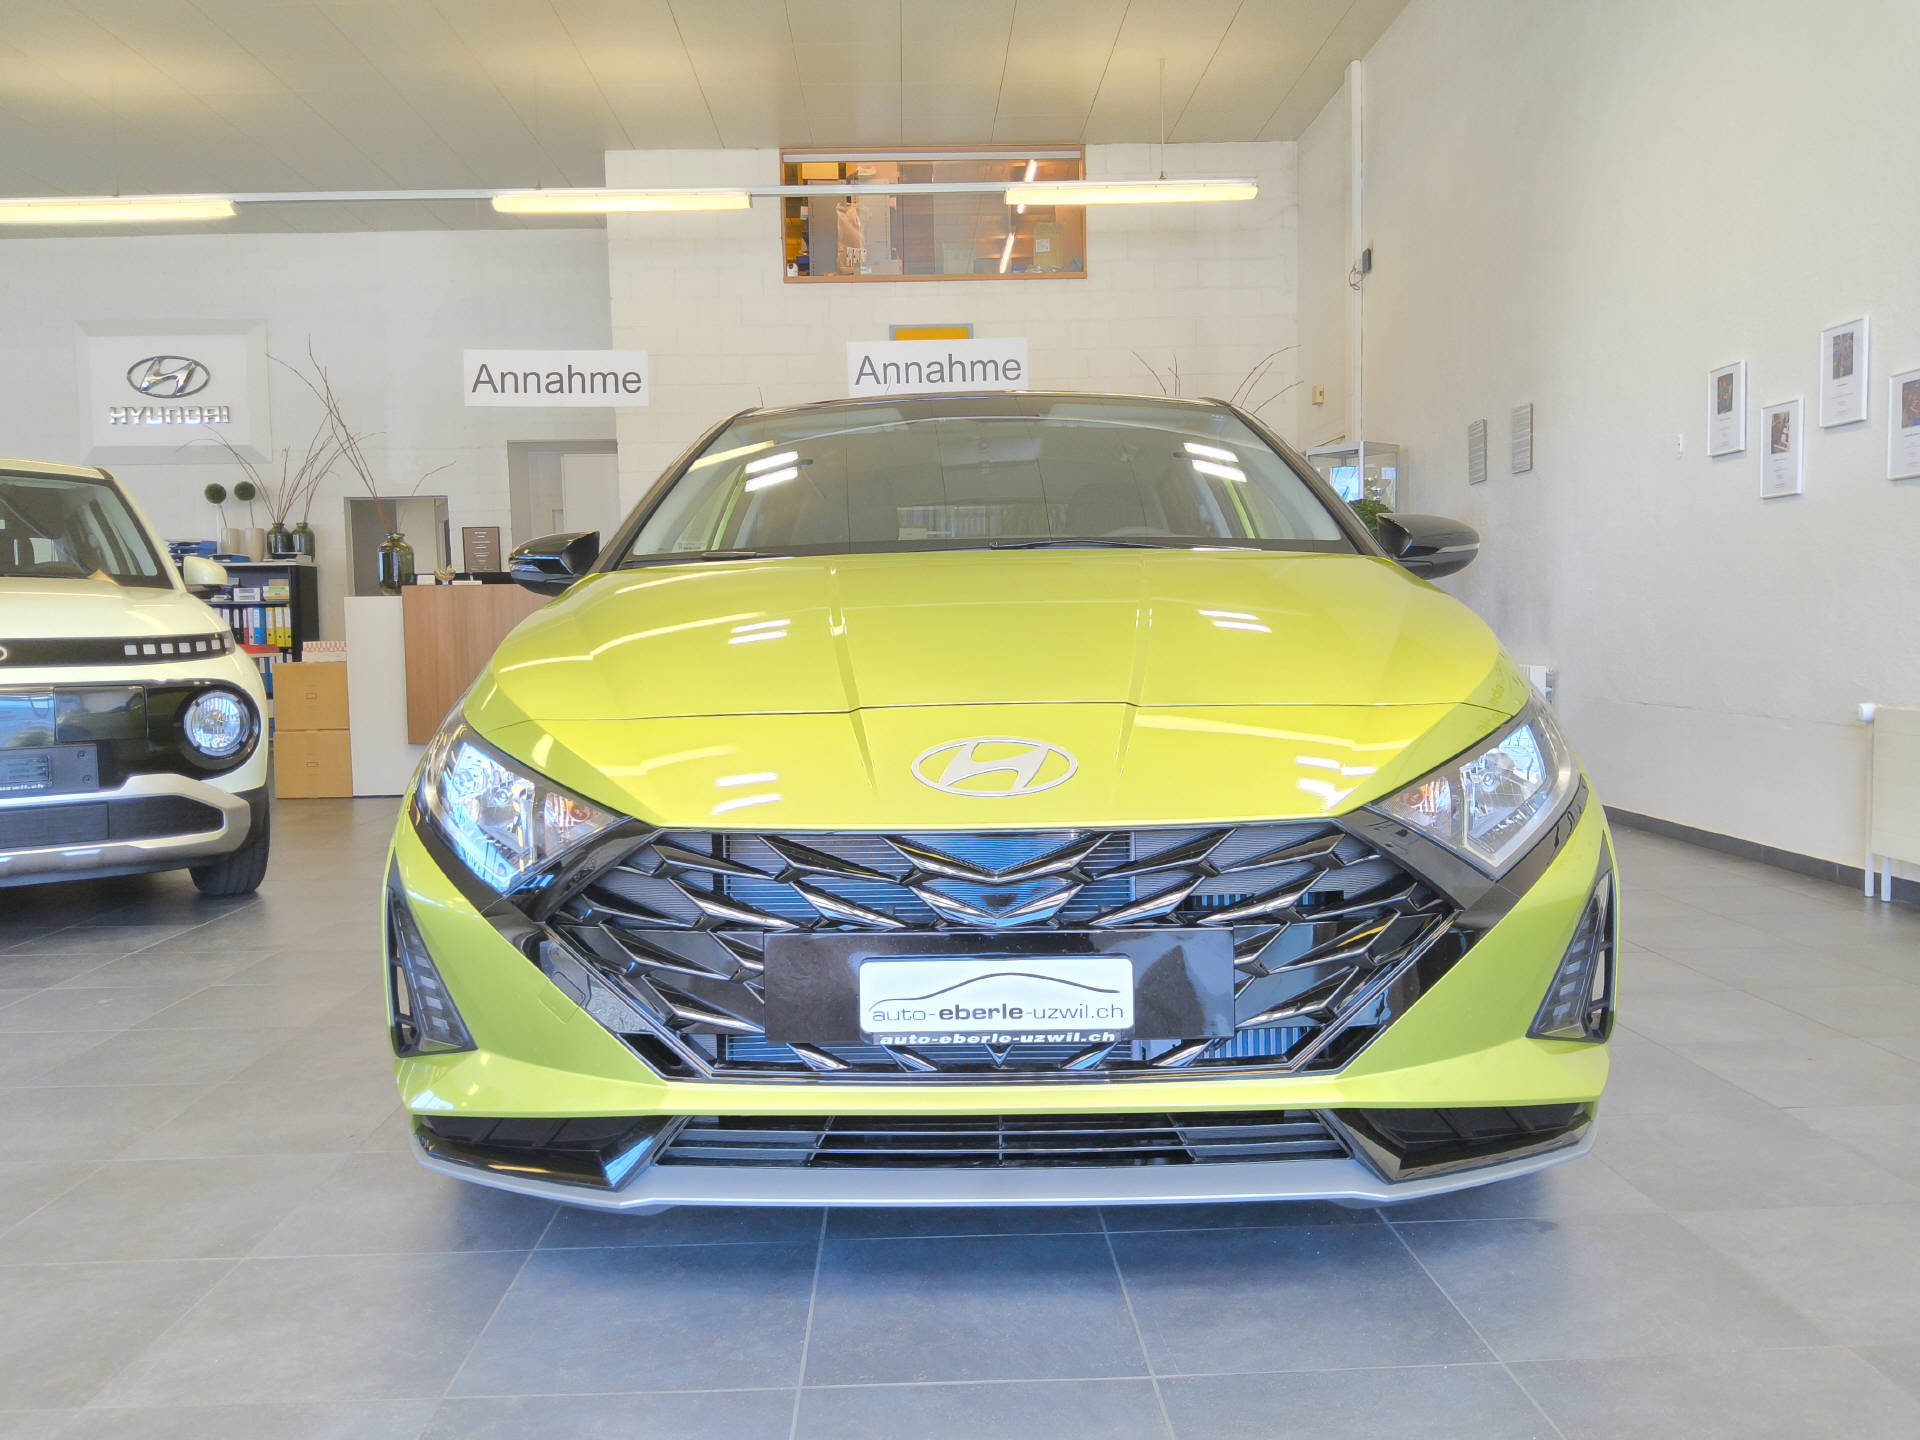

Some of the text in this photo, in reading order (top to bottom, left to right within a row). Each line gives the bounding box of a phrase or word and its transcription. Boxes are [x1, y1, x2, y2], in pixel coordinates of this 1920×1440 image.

[472, 363, 642, 394] Annahme
[855, 353, 1022, 386] Annahme
[109, 406, 230, 425] HYUNDAI
[872, 1003, 1124, 1021] auto-eberle-uzwil.ch
[880, 1032, 1116, 1045] auto-eberle-uzwil.ch
